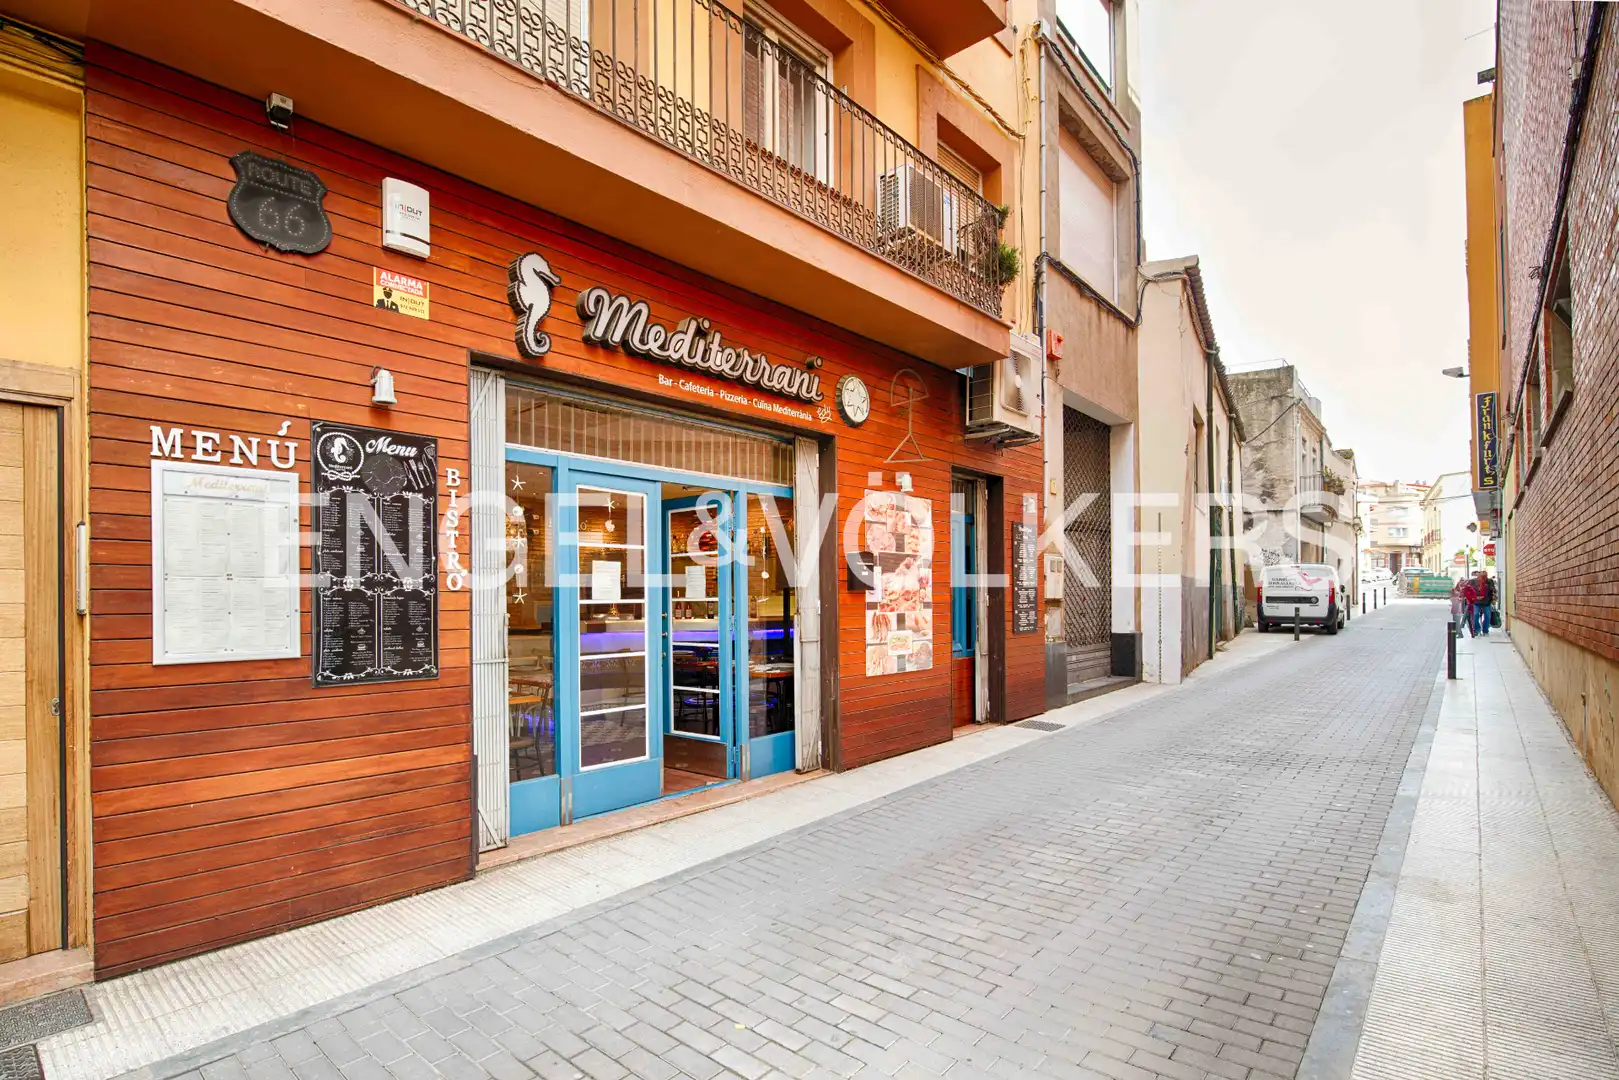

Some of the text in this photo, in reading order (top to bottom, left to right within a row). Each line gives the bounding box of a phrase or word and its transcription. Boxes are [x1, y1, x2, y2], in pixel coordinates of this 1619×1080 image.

[248, 162, 312, 196] ROUTE
[259, 196, 306, 236] 66
[380, 271, 423, 290] ALARMA
[577, 286, 824, 402] Mediterrani
[658, 374, 673, 387] Bar
[679, 379, 715, 397] Cafeteria
[720, 390, 748, 405] Pizzeria
[149, 420, 298, 469] MENÚ
[365, 436, 418, 458] Menu
[445, 467, 468, 592] BISTRÓ
